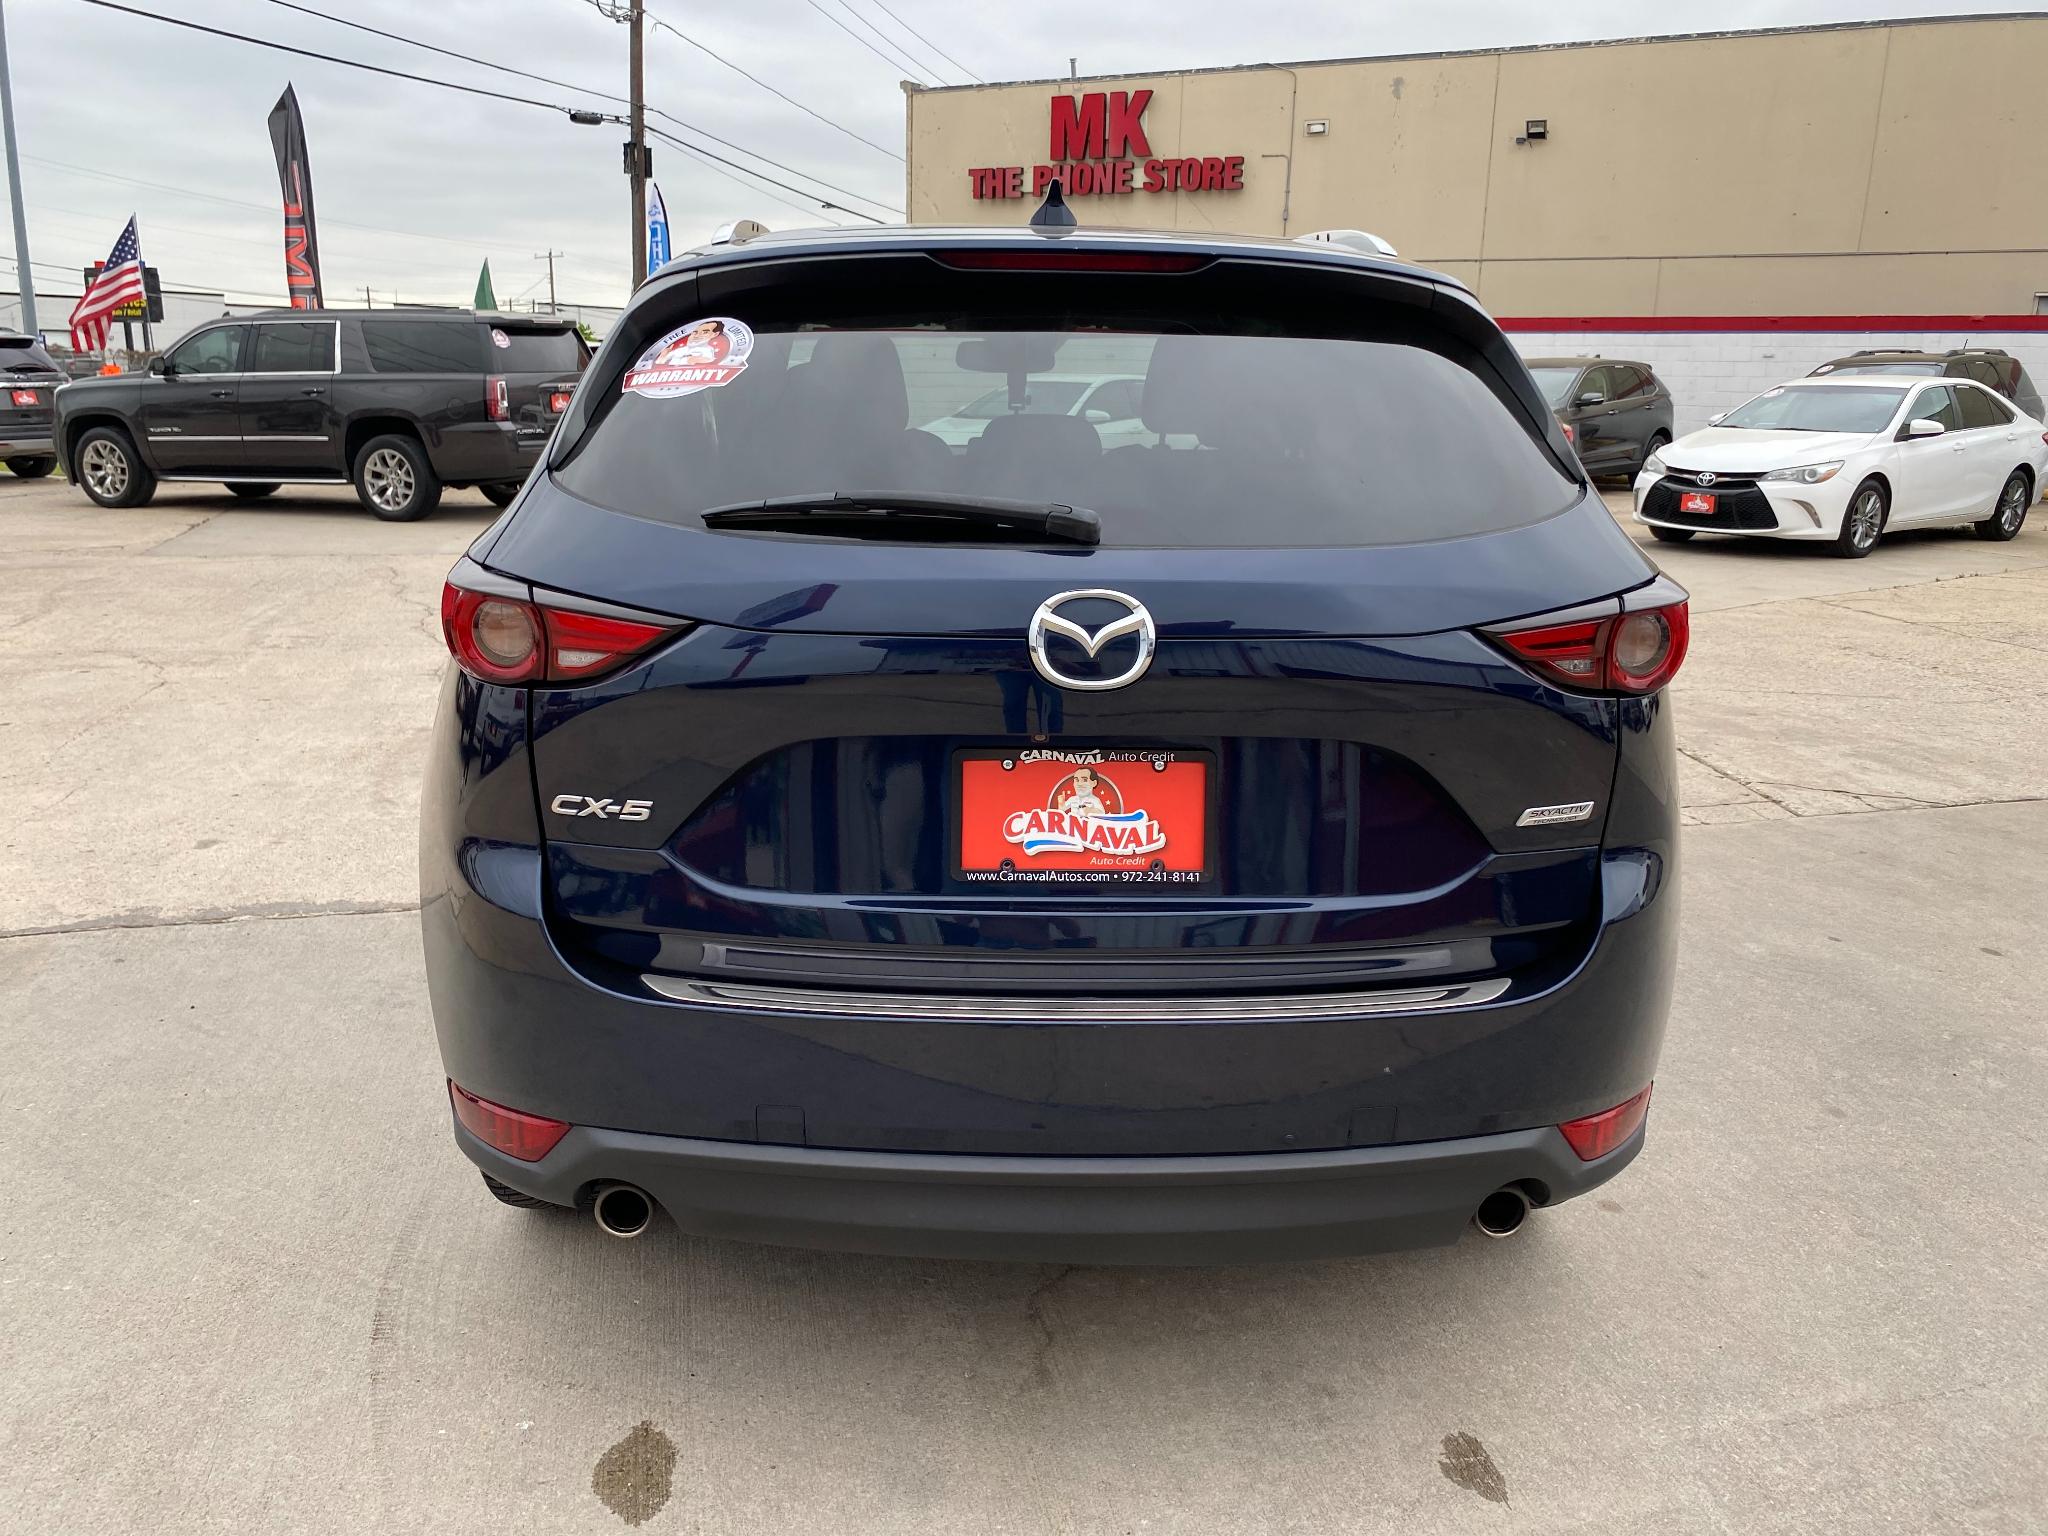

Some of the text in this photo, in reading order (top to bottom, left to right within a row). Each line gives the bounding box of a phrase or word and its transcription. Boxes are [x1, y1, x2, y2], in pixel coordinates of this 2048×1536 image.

[1050, 89, 1154, 161] MK
[968, 156, 1244, 200] THE PHONE STORE
[663, 328, 687, 344] FREE
[727, 325, 747, 347] LIMITED
[630, 369, 729, 386] WARRANTY
[1019, 749, 1175, 765] CARNAVAL Auto Credit
[551, 794, 654, 821] CX-5
[1529, 805, 1588, 817] SKYACTIV
[1003, 810, 1165, 852] CARNAVAL
[1089, 855, 1146, 866] Auto Credit
[966, 869, 1200, 882] www.CarnavalAutos.com 972-241-8141
